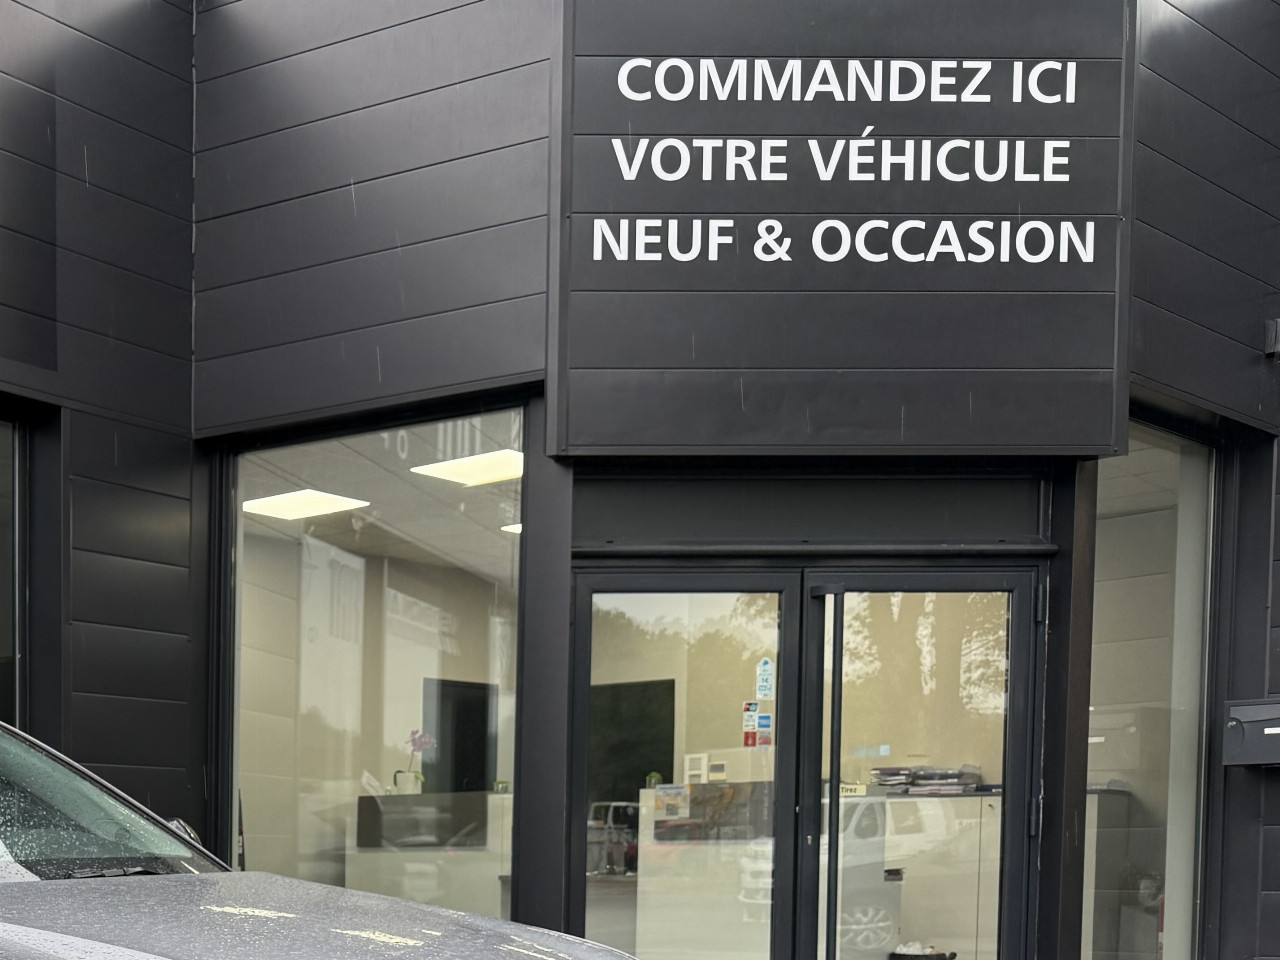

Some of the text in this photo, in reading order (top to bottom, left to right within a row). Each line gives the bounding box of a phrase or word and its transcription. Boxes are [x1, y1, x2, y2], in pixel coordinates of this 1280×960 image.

[618, 57, 1077, 104] COMMANDEZ ICI
[612, 126, 1071, 183] VOTRE VÉHICULE
[592, 218, 1096, 264] NEUF & OCCASION
[840, 786, 857, 794] Tirez
